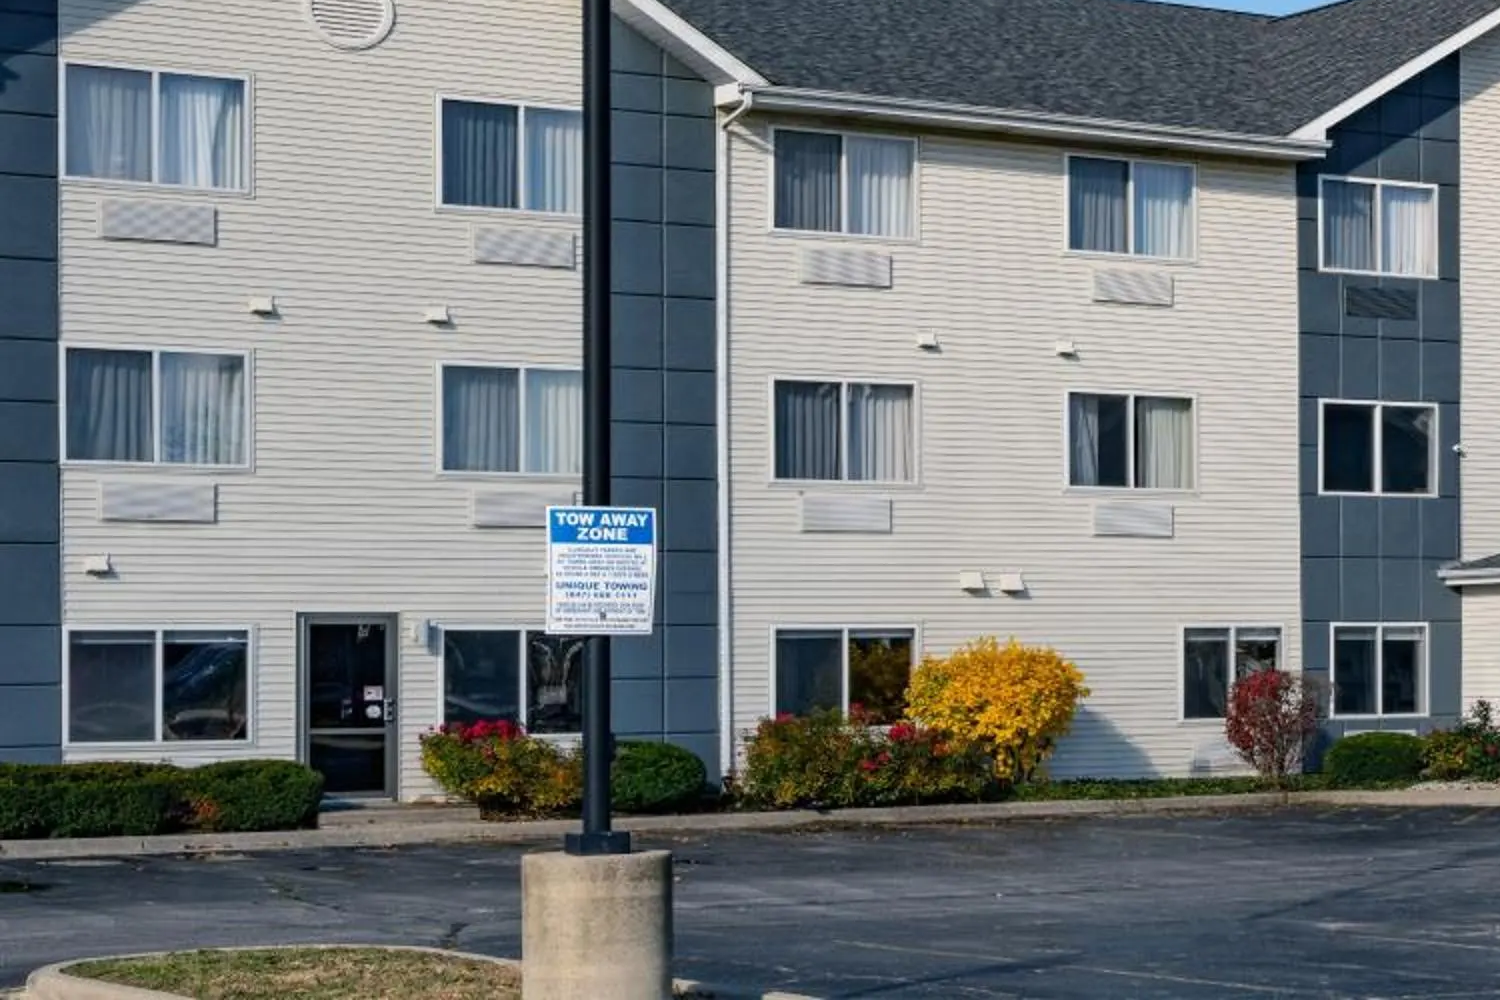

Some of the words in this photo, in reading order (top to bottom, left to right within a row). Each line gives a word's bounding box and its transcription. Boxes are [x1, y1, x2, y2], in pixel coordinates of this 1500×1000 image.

[555, 512, 595, 526] TOW
[600, 513, 649, 527] AWAY
[577, 527, 629, 541] ZONE
[555, 581, 600, 591] UNIQUE
[604, 582, 648, 592] TOWING
